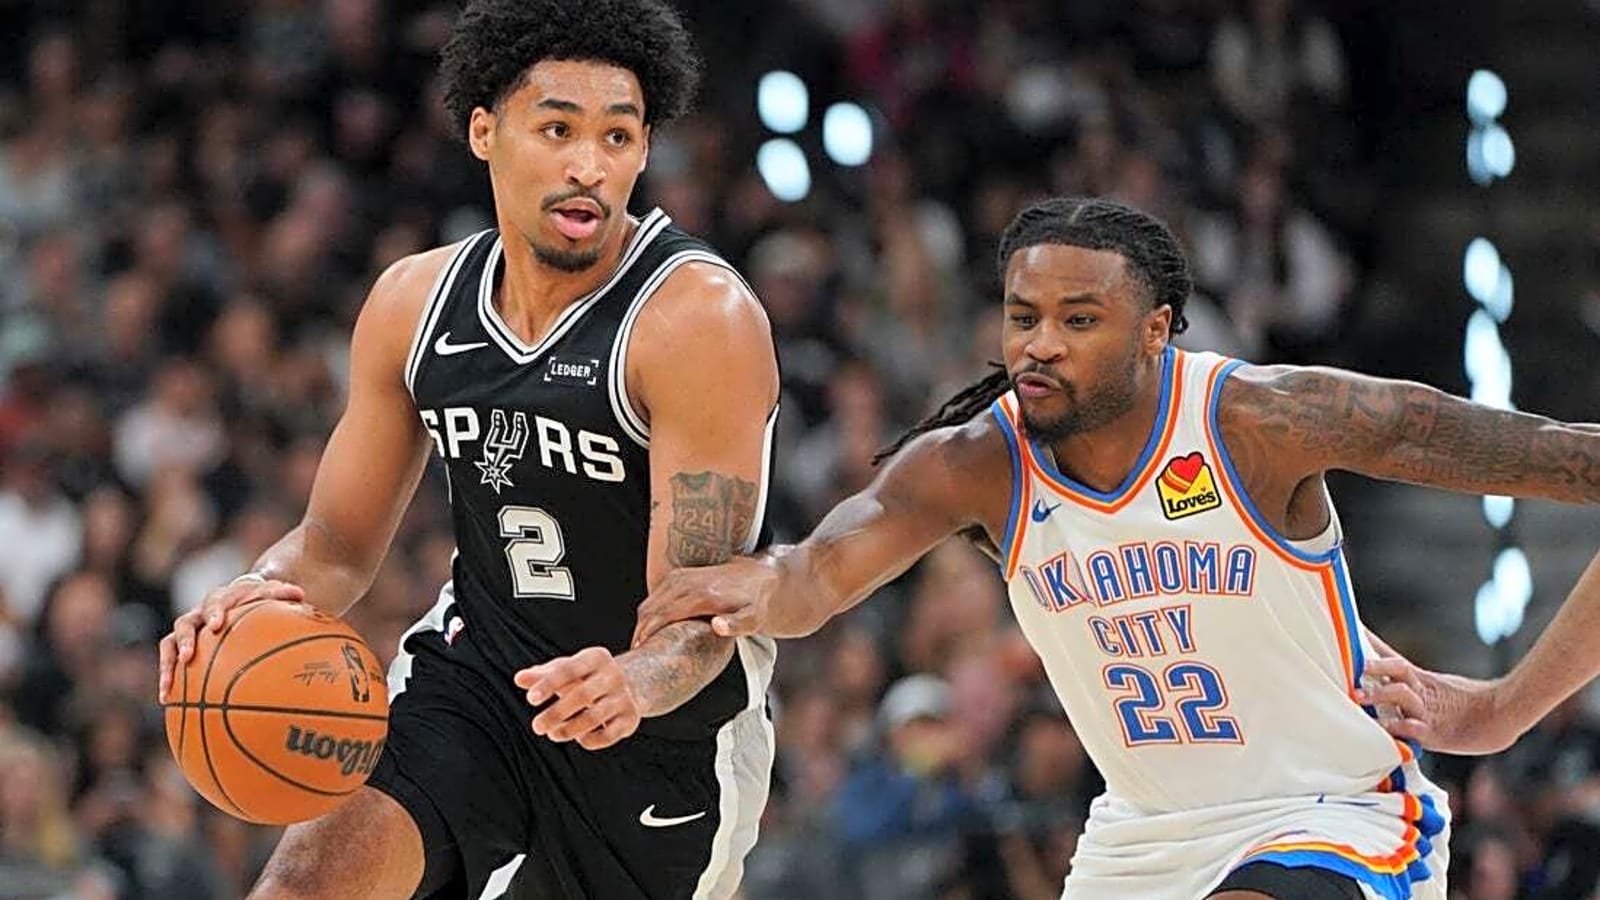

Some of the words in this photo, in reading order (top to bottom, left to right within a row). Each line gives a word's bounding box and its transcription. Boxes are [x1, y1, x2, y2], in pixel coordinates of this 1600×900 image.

[550, 362, 591, 378] LEDGER
[497, 505, 575, 602] 2
[1020, 540, 1256, 612] OKAHOMA
[1088, 604, 1197, 658] CITY
[1103, 661, 1244, 747] 22
